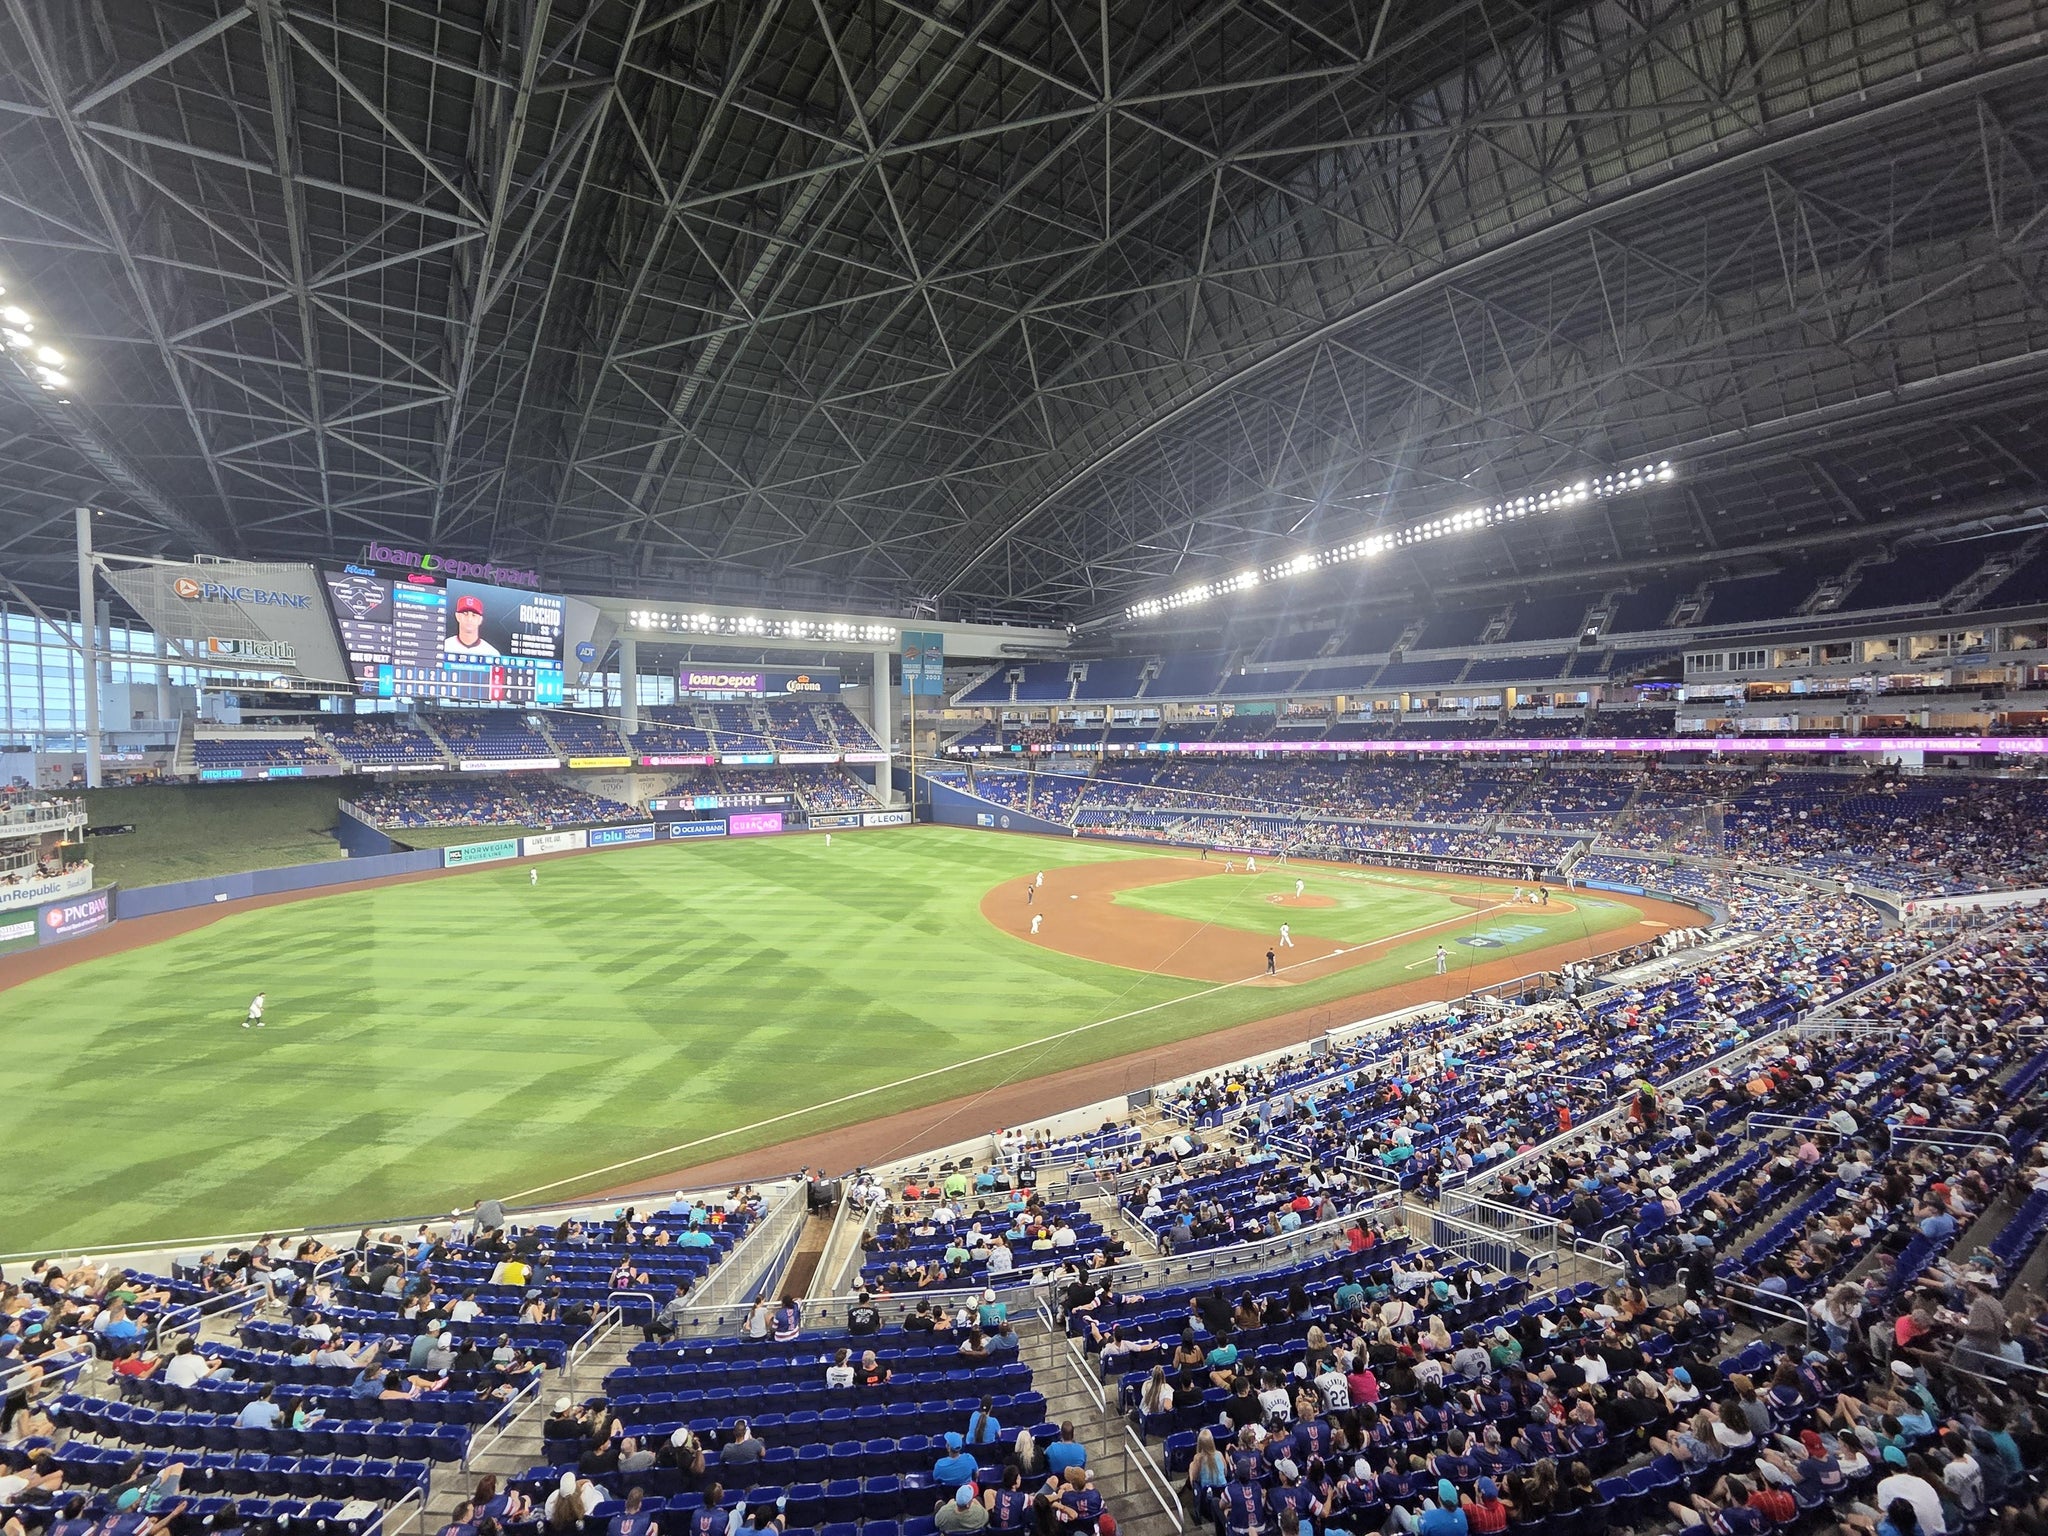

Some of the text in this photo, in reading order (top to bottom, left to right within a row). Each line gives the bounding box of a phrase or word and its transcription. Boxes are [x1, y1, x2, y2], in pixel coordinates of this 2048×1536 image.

[369, 541, 539, 586] loanDepot park
[203, 582, 312, 609] PNC BANK
[534, 597, 561, 608] BRAYAN
[520, 605, 561, 627] ROCCHIO
[242, 639, 296, 659] Health
[580, 648, 595, 657] ADT
[689, 673, 757, 688] loanDepot
[786, 679, 821, 693] Corona
[203, 770, 241, 778] PITCH SPEED
[288, 768, 302, 776] TYPE
[878, 814, 904, 822] LEON
[706, 824, 724, 832] BANK
[603, 831, 622, 841] blu
[463, 843, 514, 855] NORWEGIAN
[63, 902, 88, 923] PNC
[1476, 1361, 1487, 1374] 2
[1329, 1389, 1348, 1408] 22
